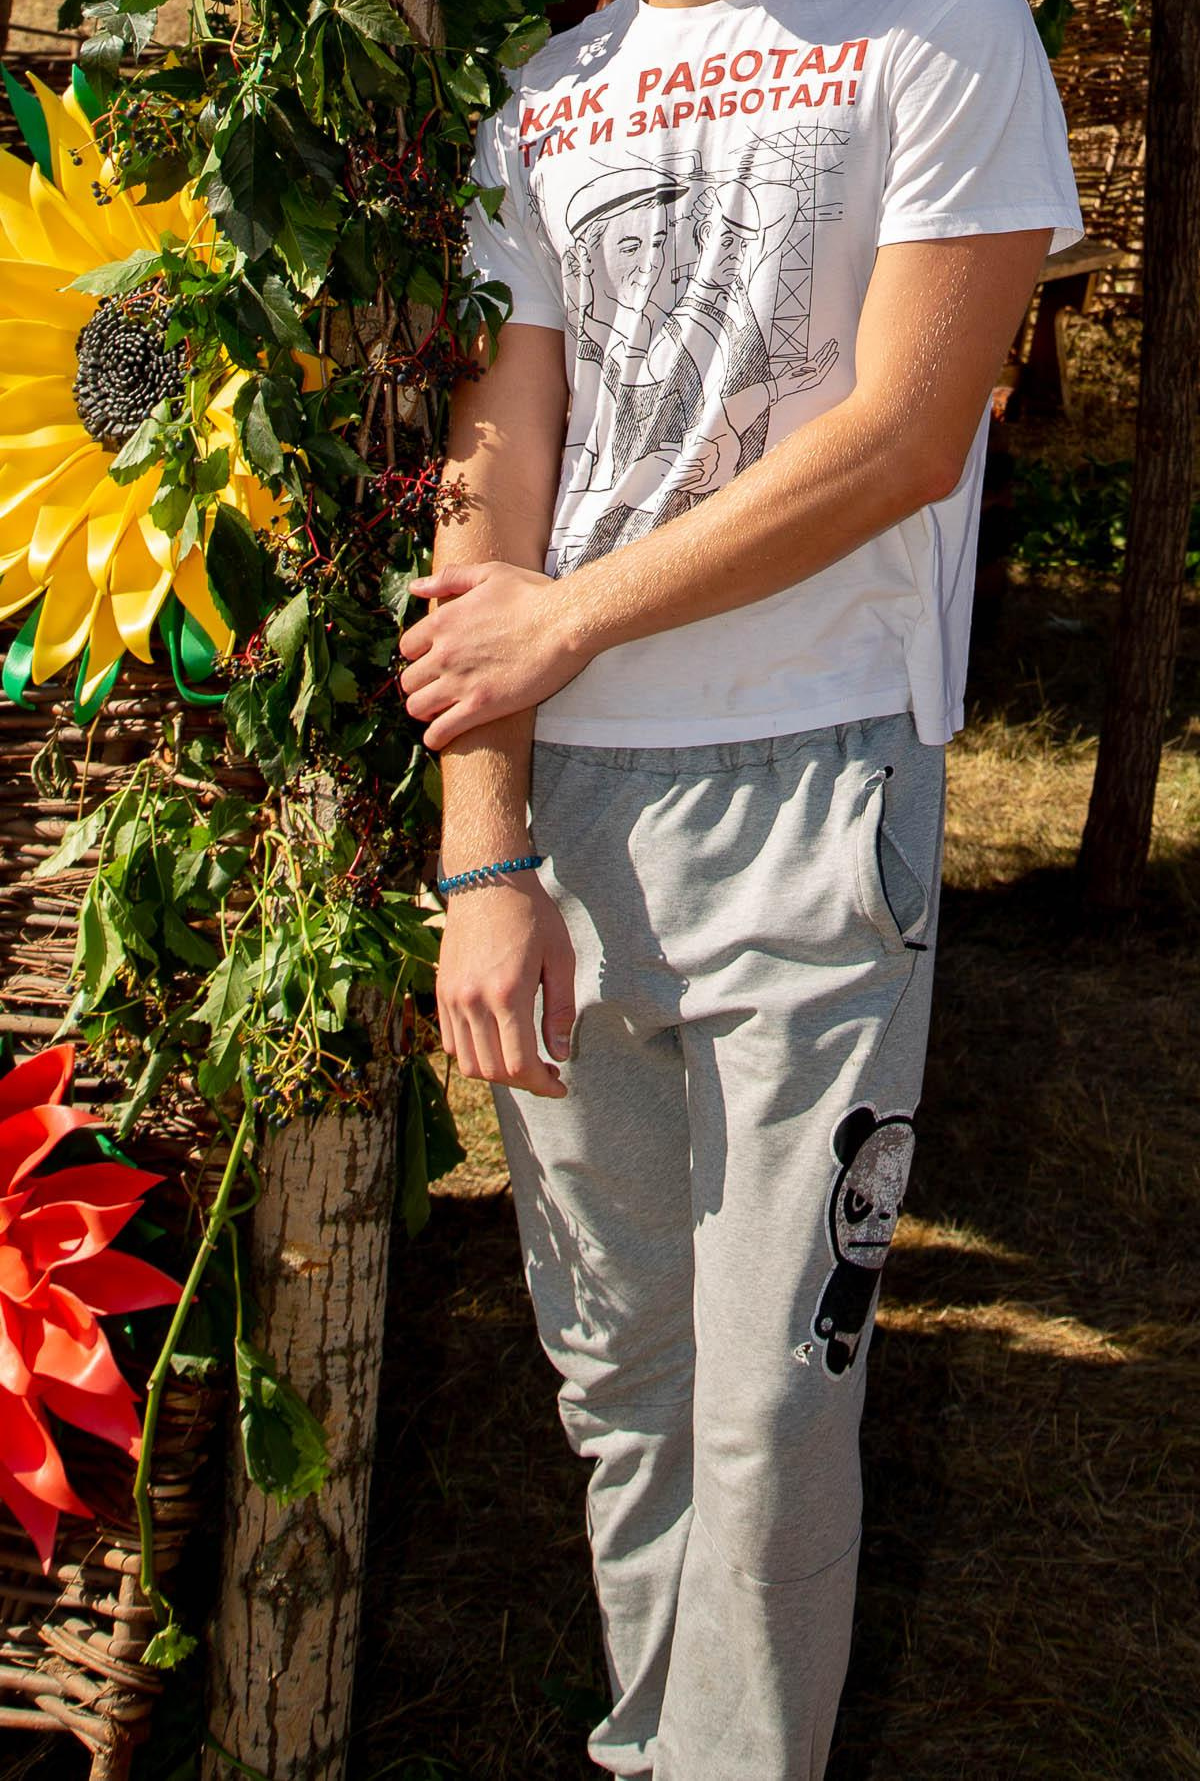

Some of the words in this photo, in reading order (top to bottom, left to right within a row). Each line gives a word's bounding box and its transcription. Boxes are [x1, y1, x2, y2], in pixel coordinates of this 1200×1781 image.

[518, 126, 578, 168] ТАК
[589, 120, 614, 146] И
[626, 79, 858, 138] ЗАРАБОТАЛ!
[519, 83, 609, 137] КАК
[636, 38, 870, 104] РАБОТАЛ
